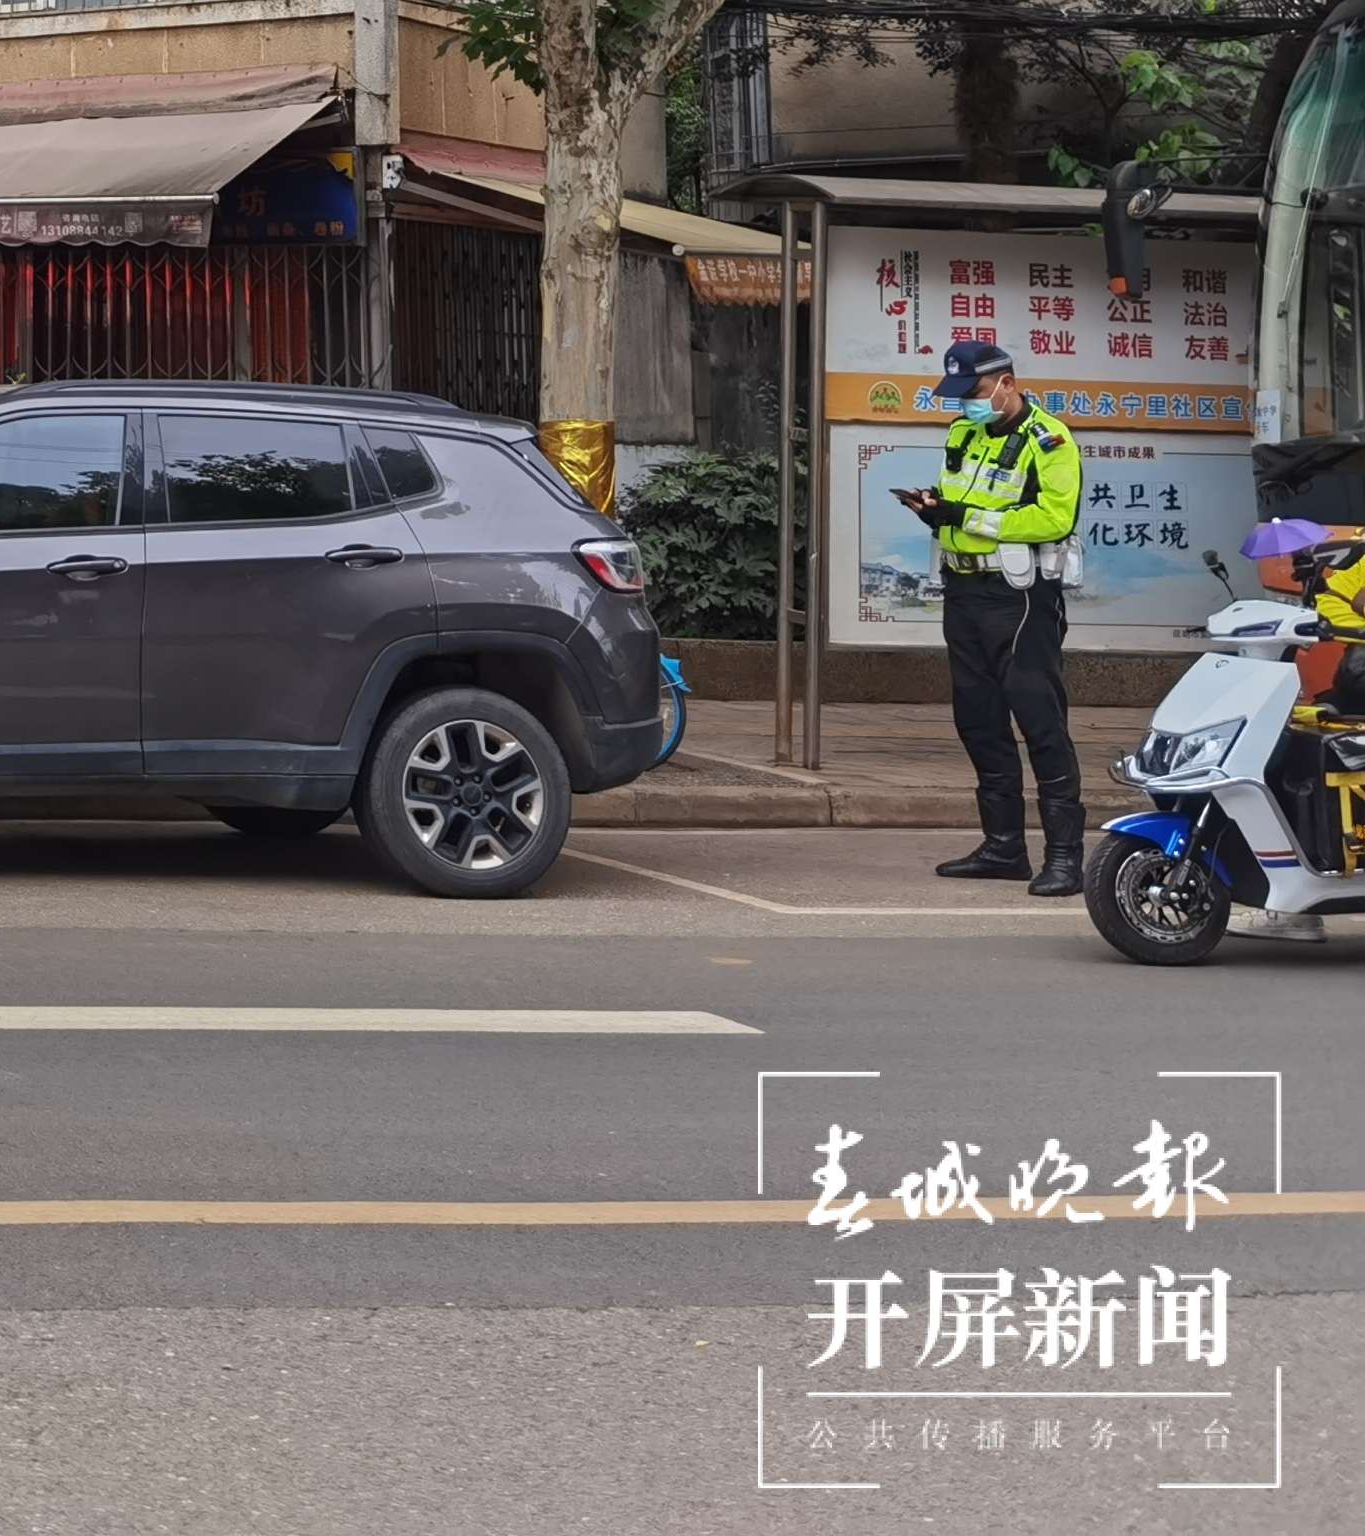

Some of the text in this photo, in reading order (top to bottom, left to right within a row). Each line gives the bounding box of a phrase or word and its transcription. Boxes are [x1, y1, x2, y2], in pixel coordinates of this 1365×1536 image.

[949, 259, 996, 285] 富强
[1028, 263, 1075, 289] 民主
[1182, 268, 1228, 295] 和谐
[951, 293, 1229, 328] 自由 平等 公正 法治
[951, 326, 1230, 362] 爱国 敬业 诚信 友善
[1078, 445, 1157, 460] 生城市成果
[1088, 482, 1183, 511] 共卫生
[1088, 521, 1190, 550] 化环境
